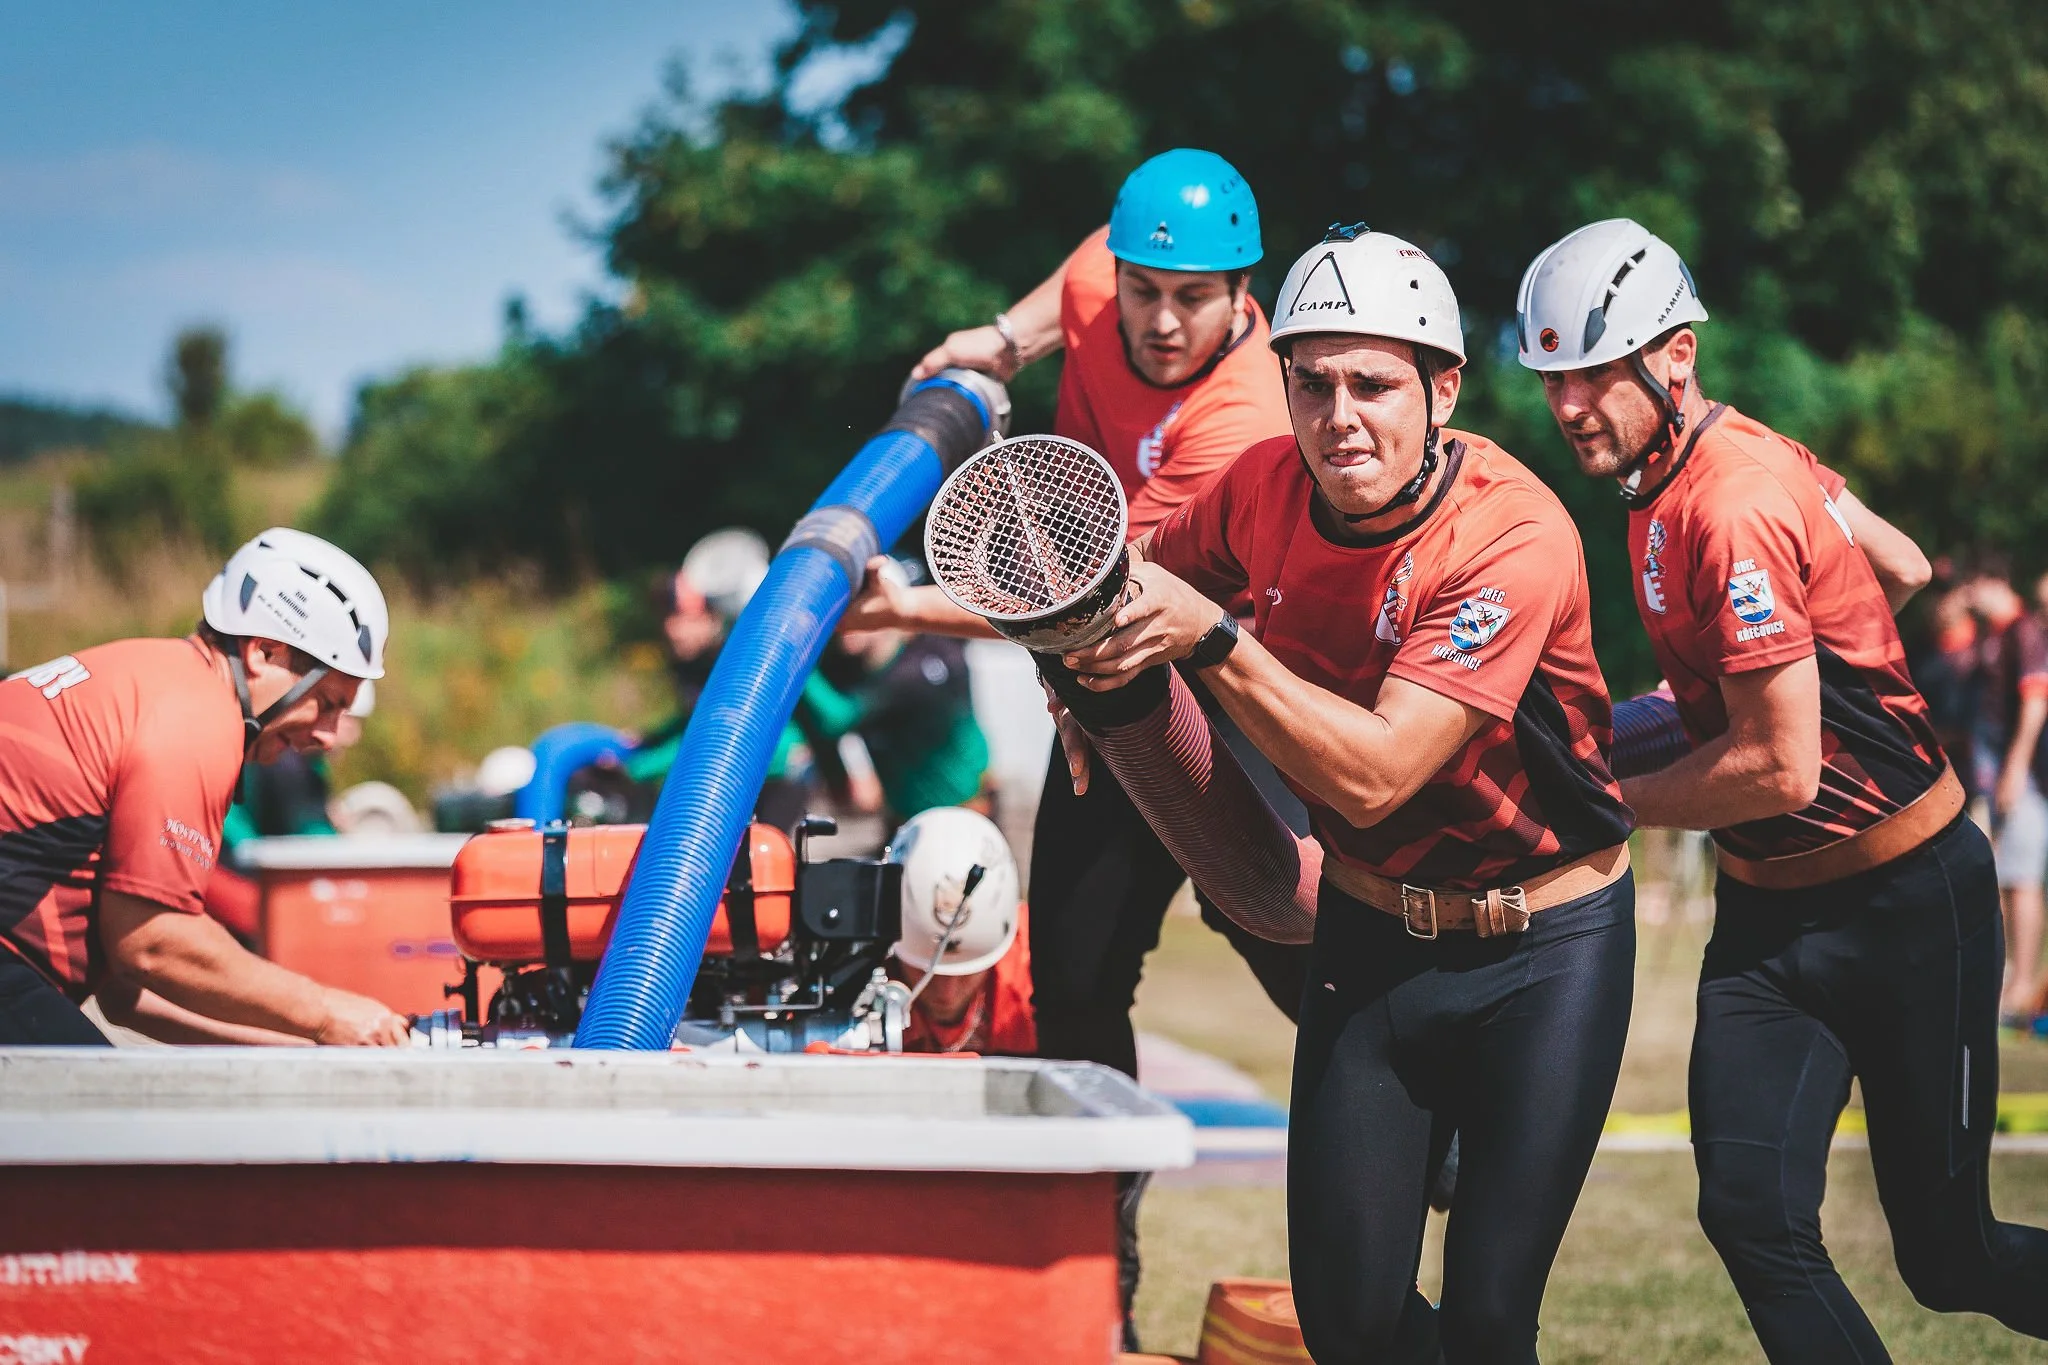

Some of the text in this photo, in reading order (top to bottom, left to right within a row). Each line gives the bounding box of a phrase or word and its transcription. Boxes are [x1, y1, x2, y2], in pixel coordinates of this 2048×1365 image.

[1298, 300, 1348, 312] CAMP
[1657, 277, 1687, 325] MAMMUT
[1732, 558, 1757, 575] OBEC
[1477, 586, 1507, 604] OBEC
